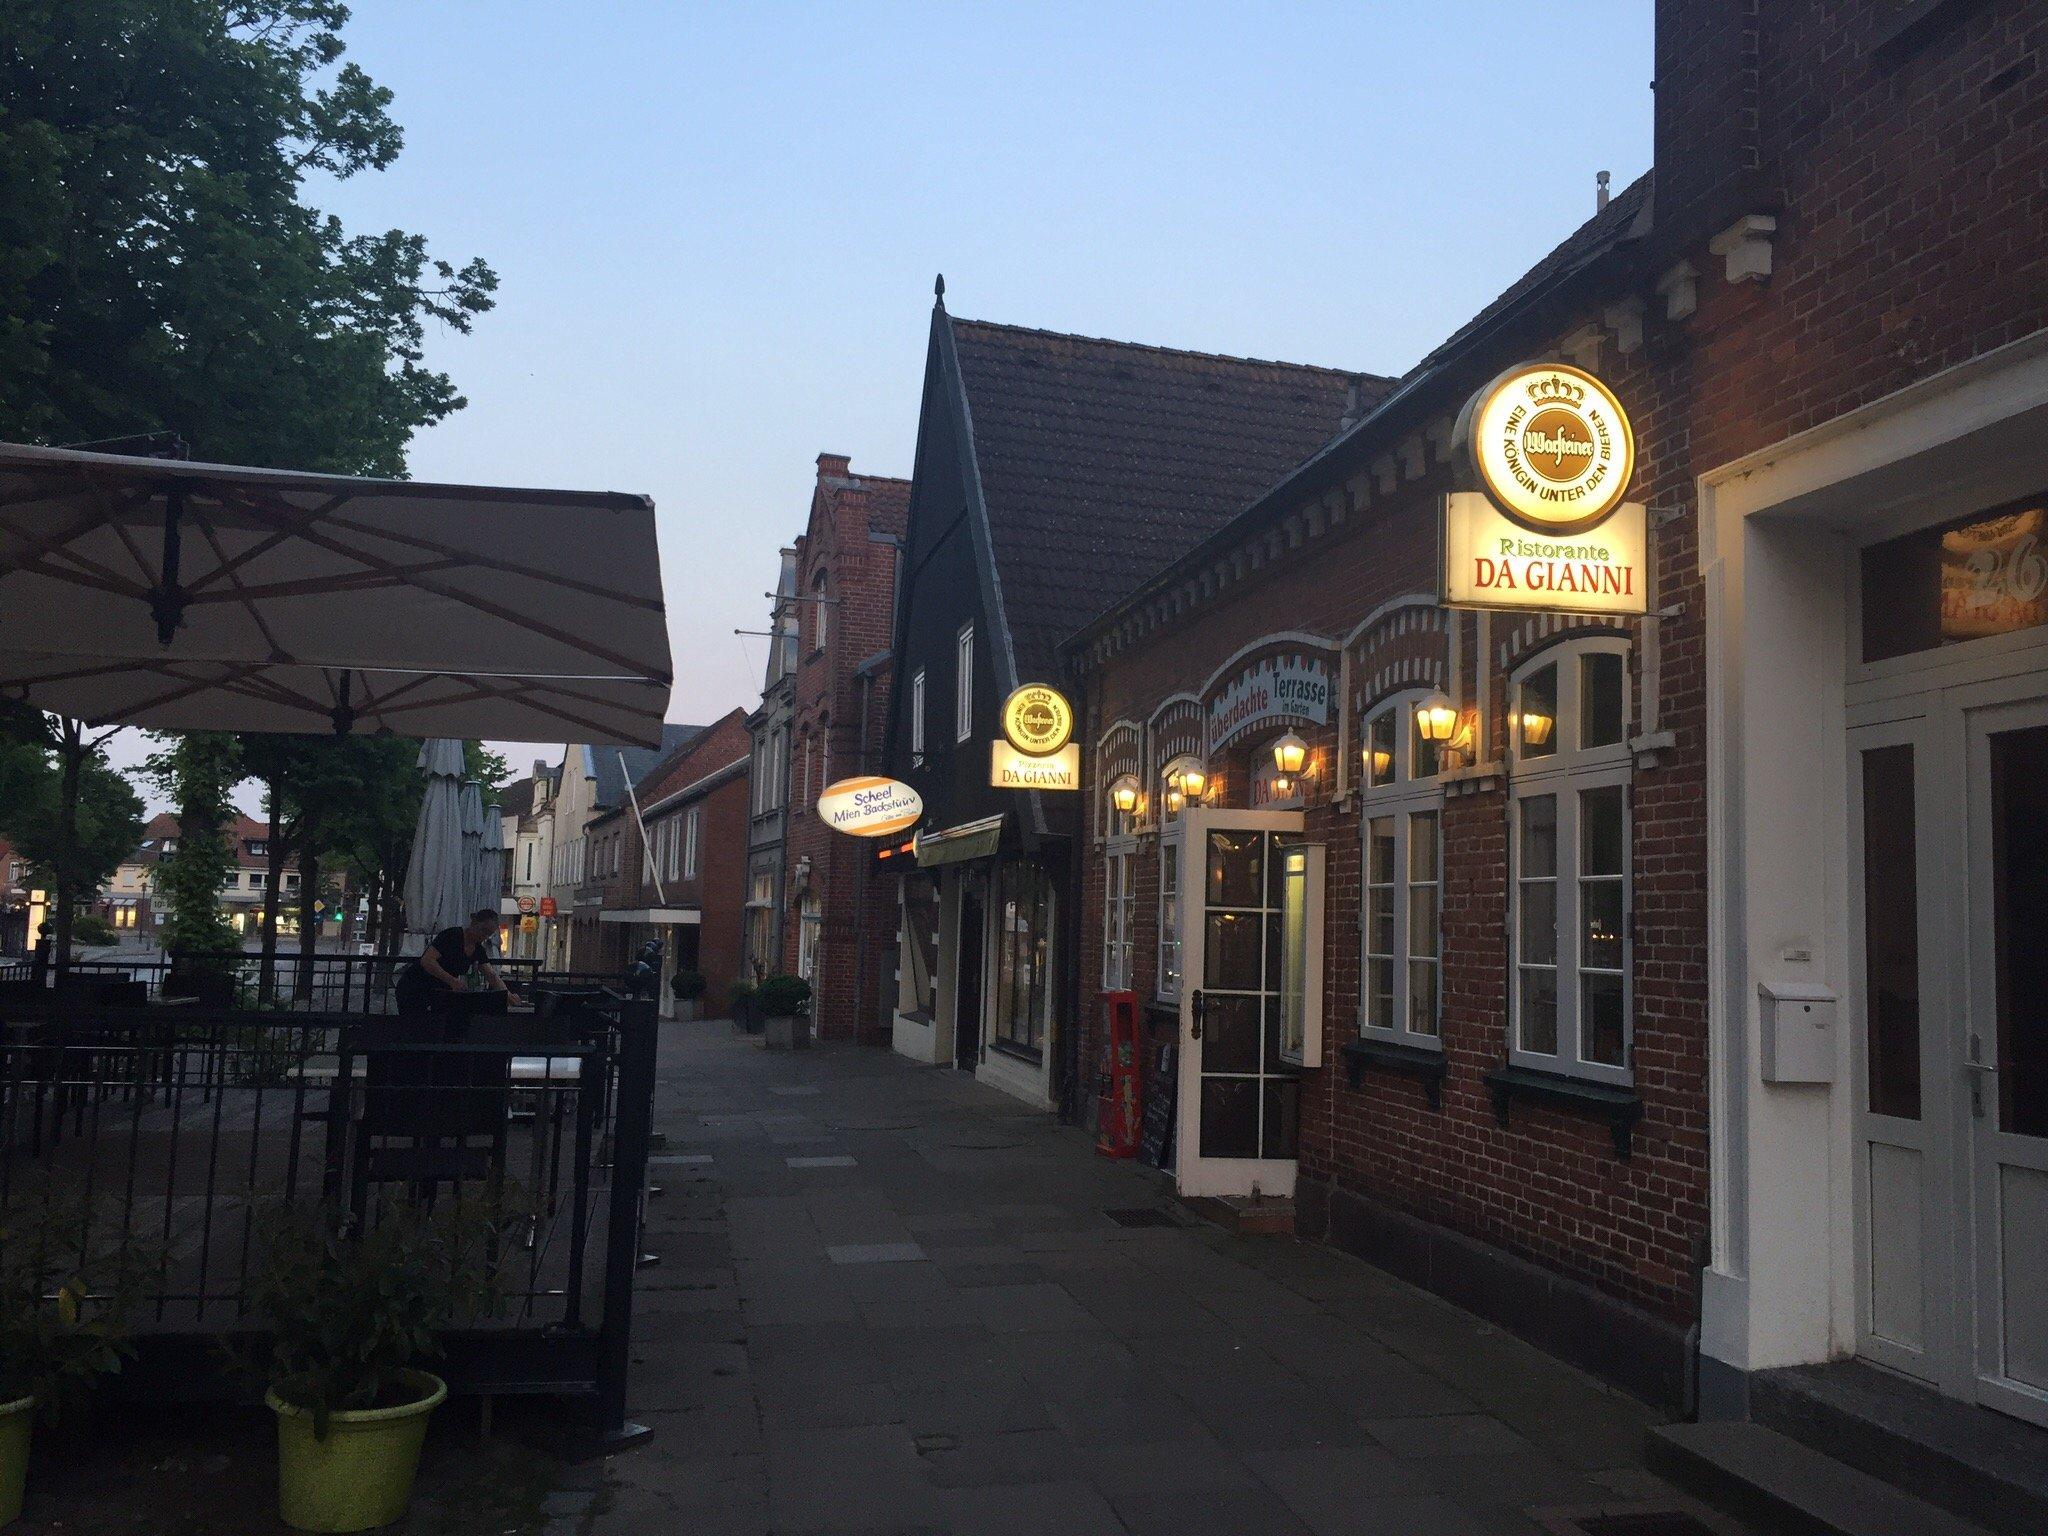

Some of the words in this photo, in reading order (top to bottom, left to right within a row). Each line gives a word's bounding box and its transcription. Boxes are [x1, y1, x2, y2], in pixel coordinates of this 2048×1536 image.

[1504, 404, 1527, 434] EINE
[1588, 409, 1611, 461] BIEREN
[1503, 438, 1538, 494] KÖNIGIN
[1586, 465, 1608, 492] DEN
[1539, 485, 1586, 502] UNTER
[1500, 538, 1610, 562] Ristorante
[1474, 558, 1517, 589] DA
[1525, 561, 1634, 596] GIANNI
[1273, 672, 1326, 705] Terrasse
[1002, 769, 1020, 783] DA
[1024, 770, 1072, 785] GIANNI
[854, 785, 892, 807] Scheel
[834, 809, 861, 824] Mien
